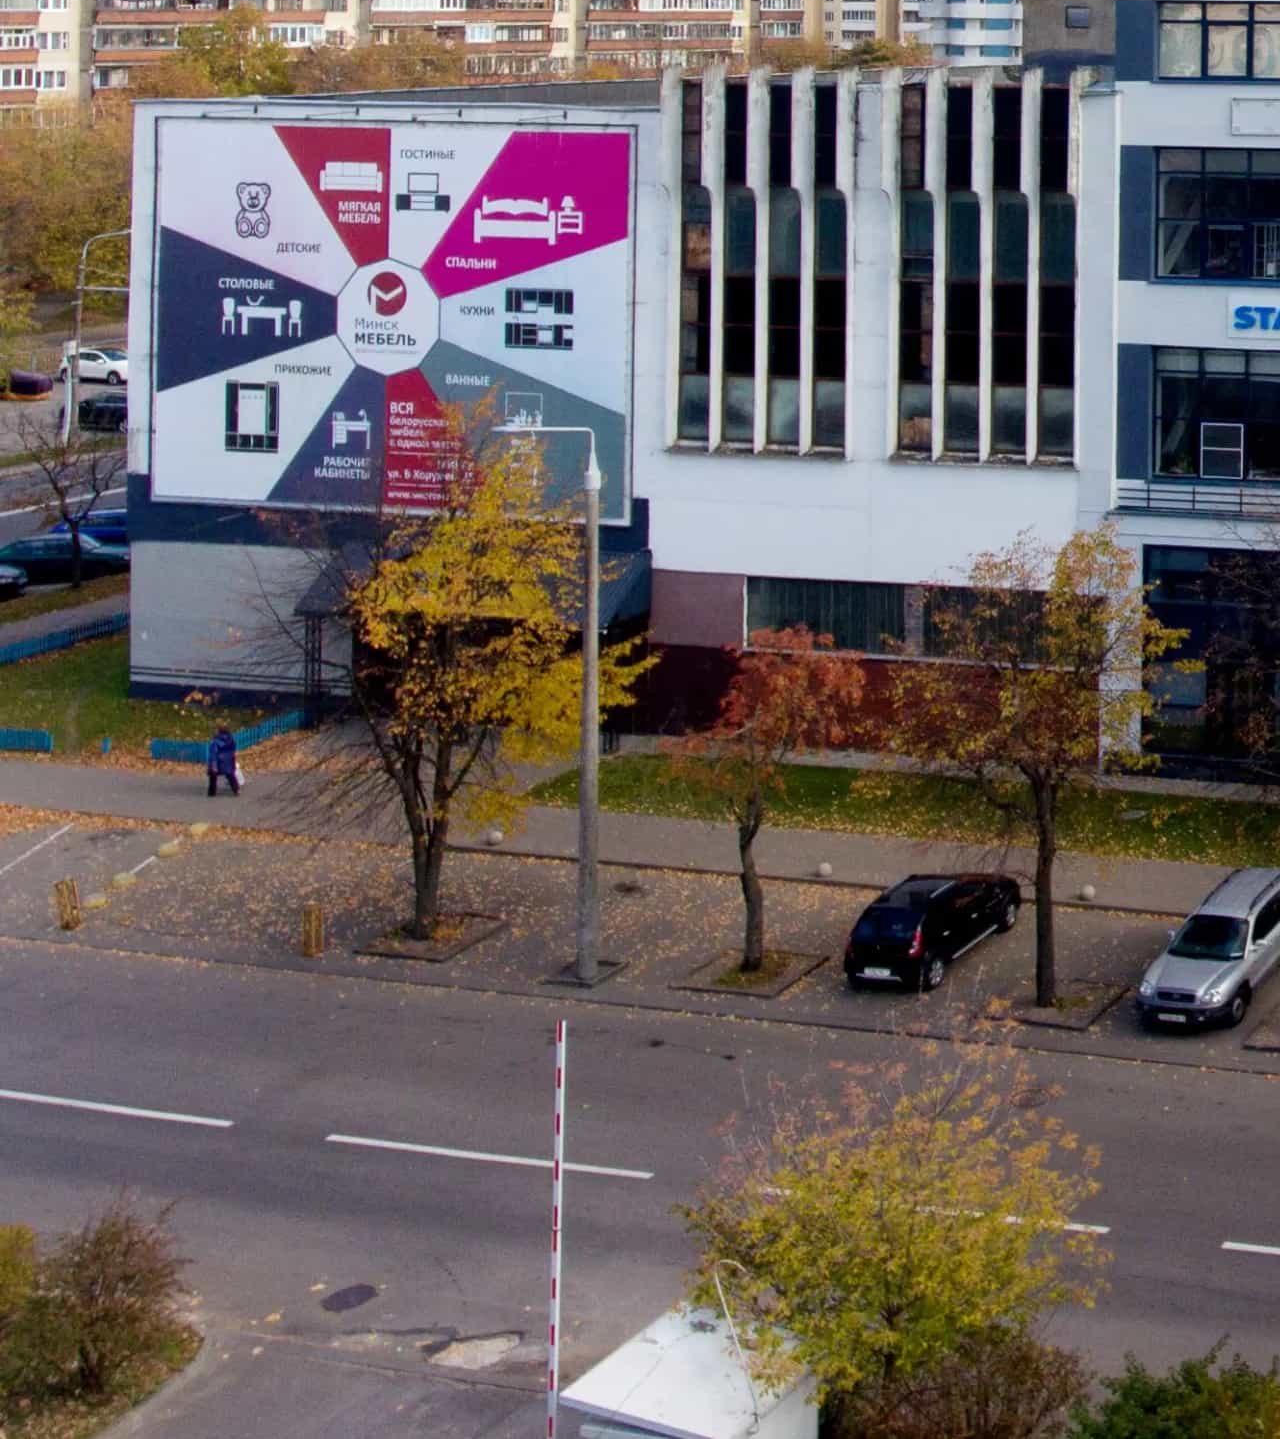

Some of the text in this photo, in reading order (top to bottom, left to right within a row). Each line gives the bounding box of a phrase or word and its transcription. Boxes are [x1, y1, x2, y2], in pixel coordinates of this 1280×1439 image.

[400, 149, 456, 160] ГОСТИНЫЕ
[338, 201, 381, 212] МЯГКАЯ
[338, 213, 381, 224] МЕБЕЛЬ
[276, 242, 321, 254] ДЕТСКИЕ
[445, 257, 497, 269] СПАЛЬНИ
[218, 278, 275, 289] СТОЛОВЫЕ
[460, 306, 495, 316] КУХНИ
[354, 333, 417, 346] МЕБЕЛЬ
[274, 364, 332, 376] ПРИХОЖИЕ
[445, 374, 490, 386] ВАННЫЕ
[389, 401, 414, 415] ВСЯ
